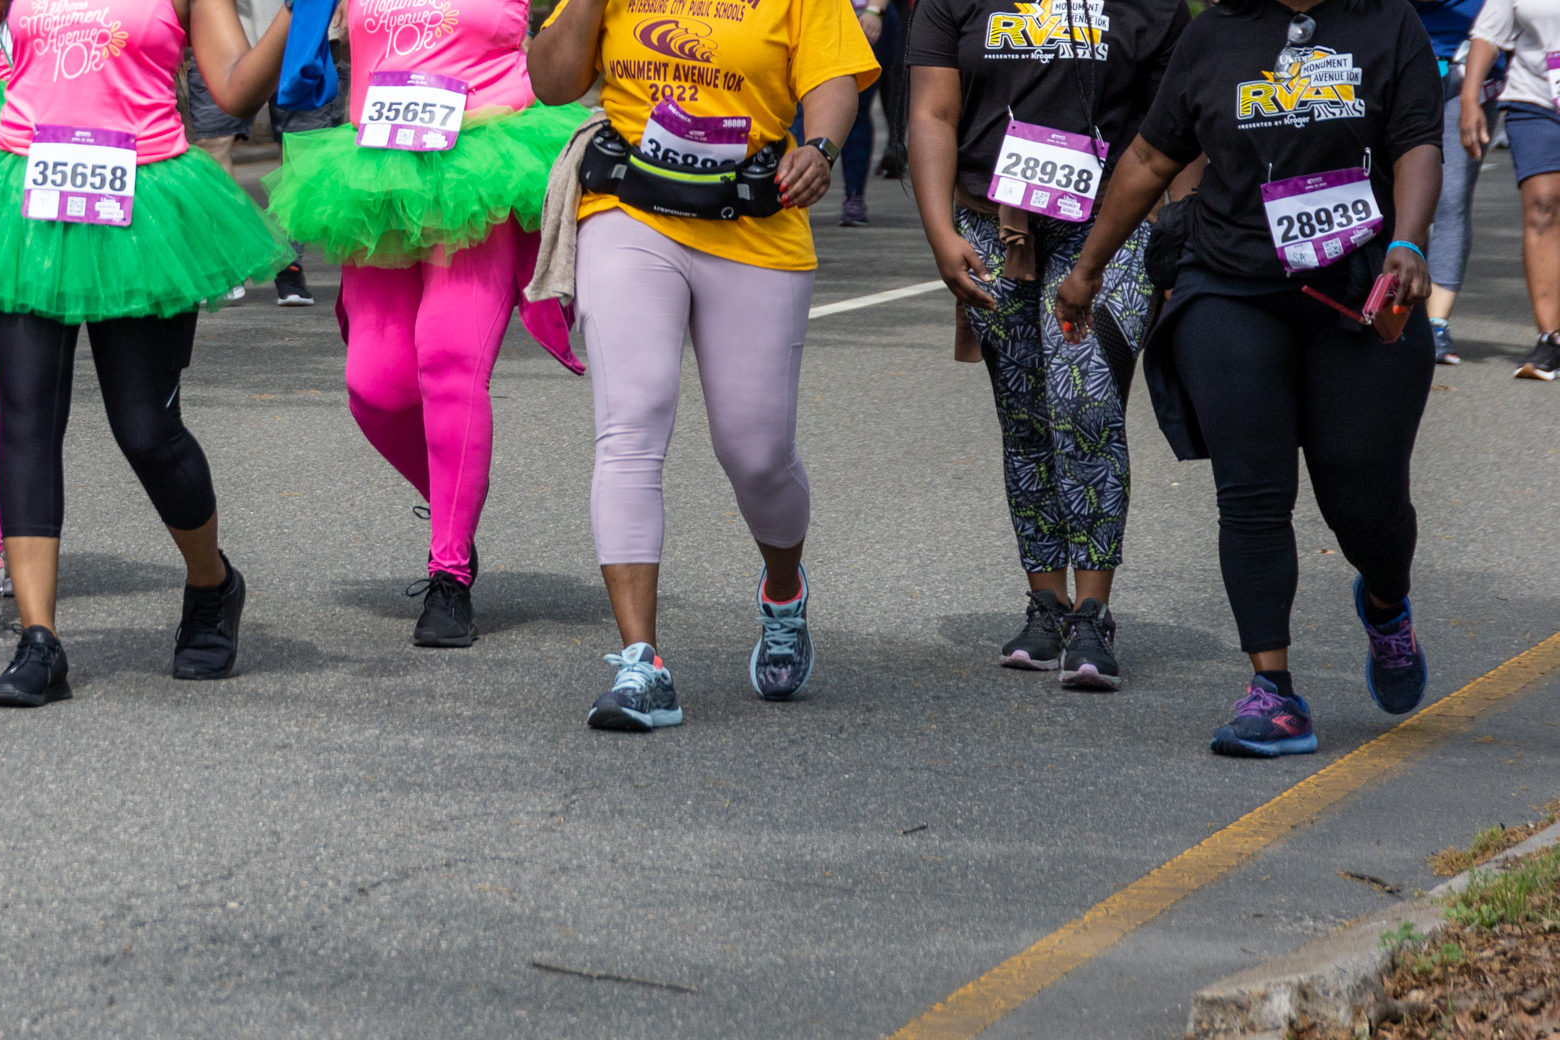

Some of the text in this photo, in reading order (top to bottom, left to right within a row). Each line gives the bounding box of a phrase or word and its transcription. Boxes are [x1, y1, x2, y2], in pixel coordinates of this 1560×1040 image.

[19, 7, 113, 37] Monument
[364, 10, 430, 34] Avenue
[670, 0, 687, 15] CITY
[688, 0, 713, 17] PUBLIC
[714, 1, 746, 22] SCHOOLS
[34, 27, 98, 56] Avenue
[1031, 49, 1056, 64] Kroger
[1303, 58, 1348, 74] MONUMENT
[609, 59, 745, 92] MONUMENT AVENUE 10K
[1313, 70, 1344, 82] AVENUE
[648, 83, 699, 102] 2022
[1237, 80, 1352, 120] RVA
[368, 101, 457, 127] 35657
[722, 118, 746, 129] 36889
[1284, 113, 1310, 128] Kroger
[32, 160, 128, 192] 35658
[1001, 152, 1094, 194] 28938
[1277, 199, 1372, 243] 28939
